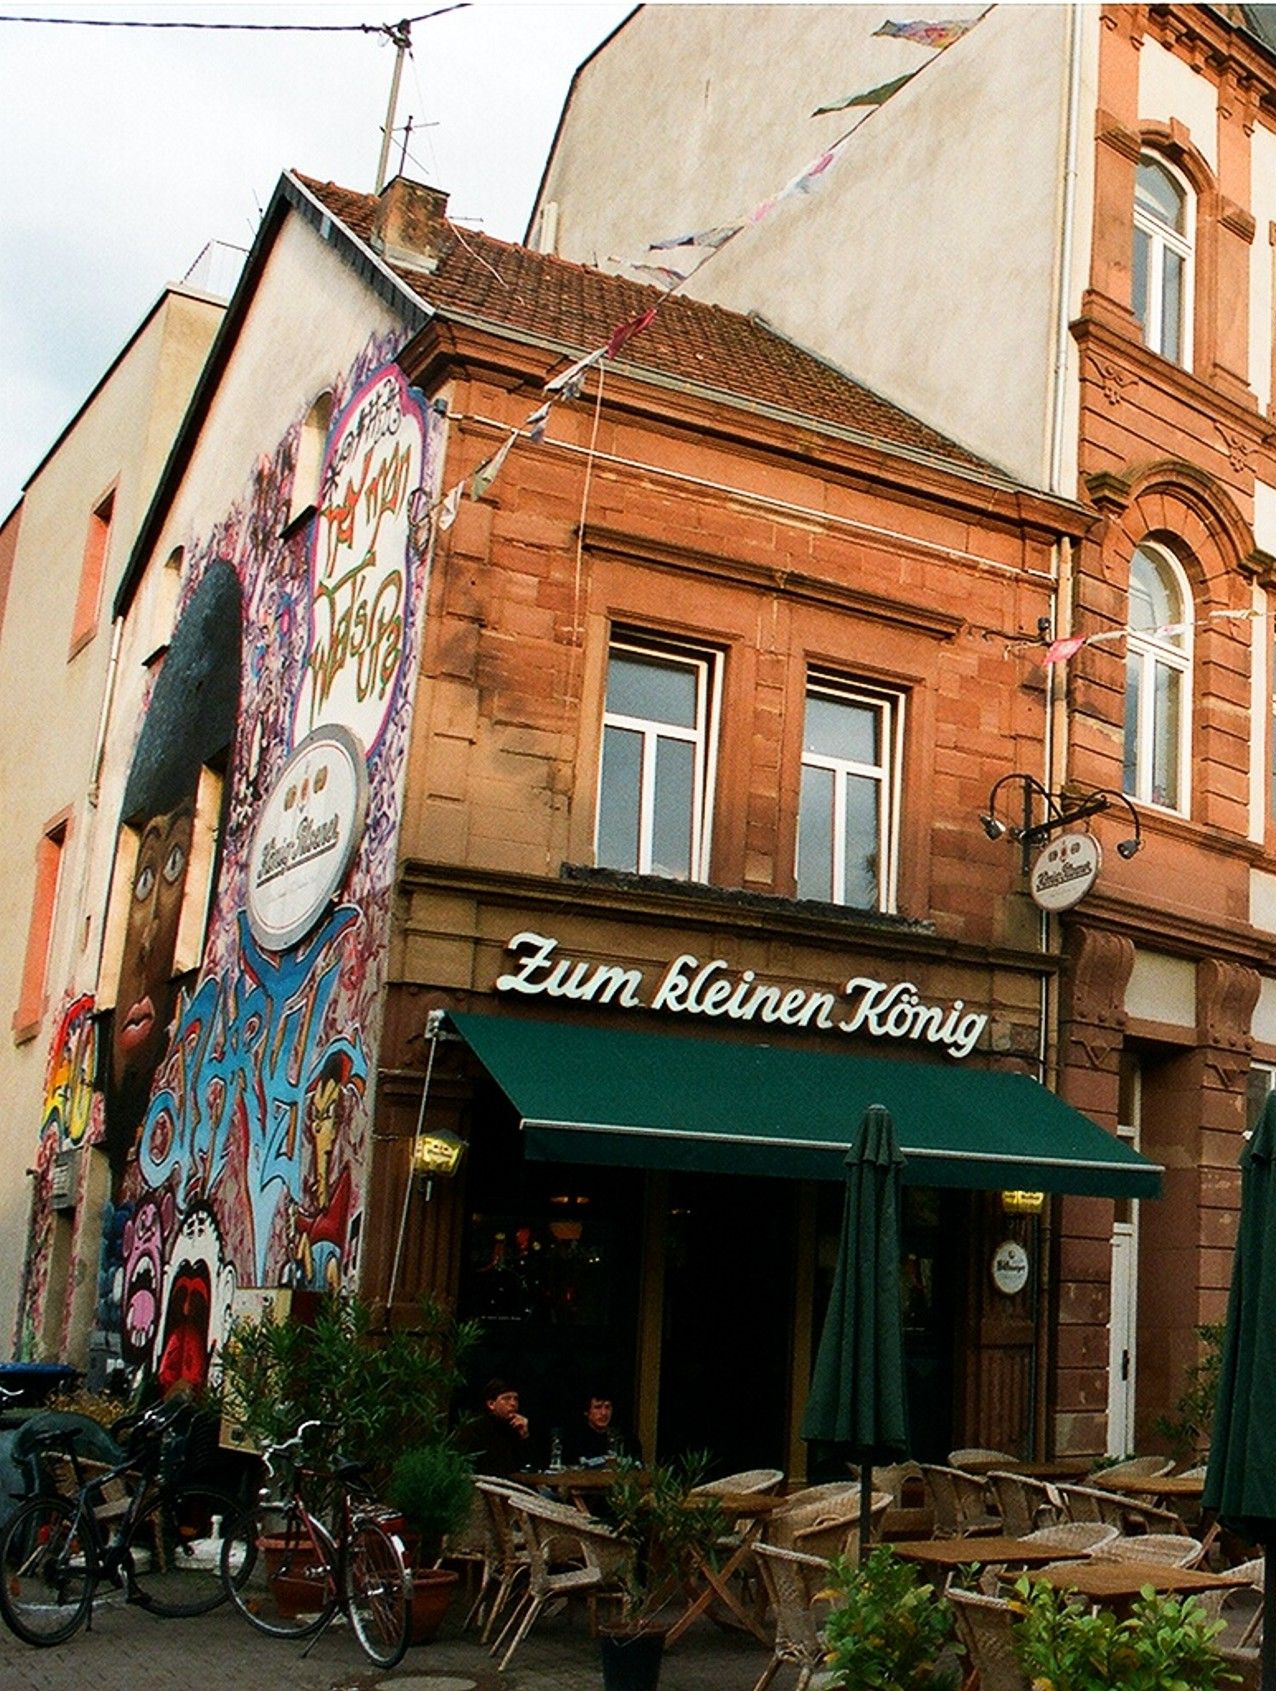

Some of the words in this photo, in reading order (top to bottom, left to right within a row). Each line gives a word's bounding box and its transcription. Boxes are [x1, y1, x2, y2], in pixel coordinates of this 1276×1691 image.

[497, 931, 643, 1008] Zum
[651, 954, 834, 1029] kleinen
[840, 976, 989, 1058] König
